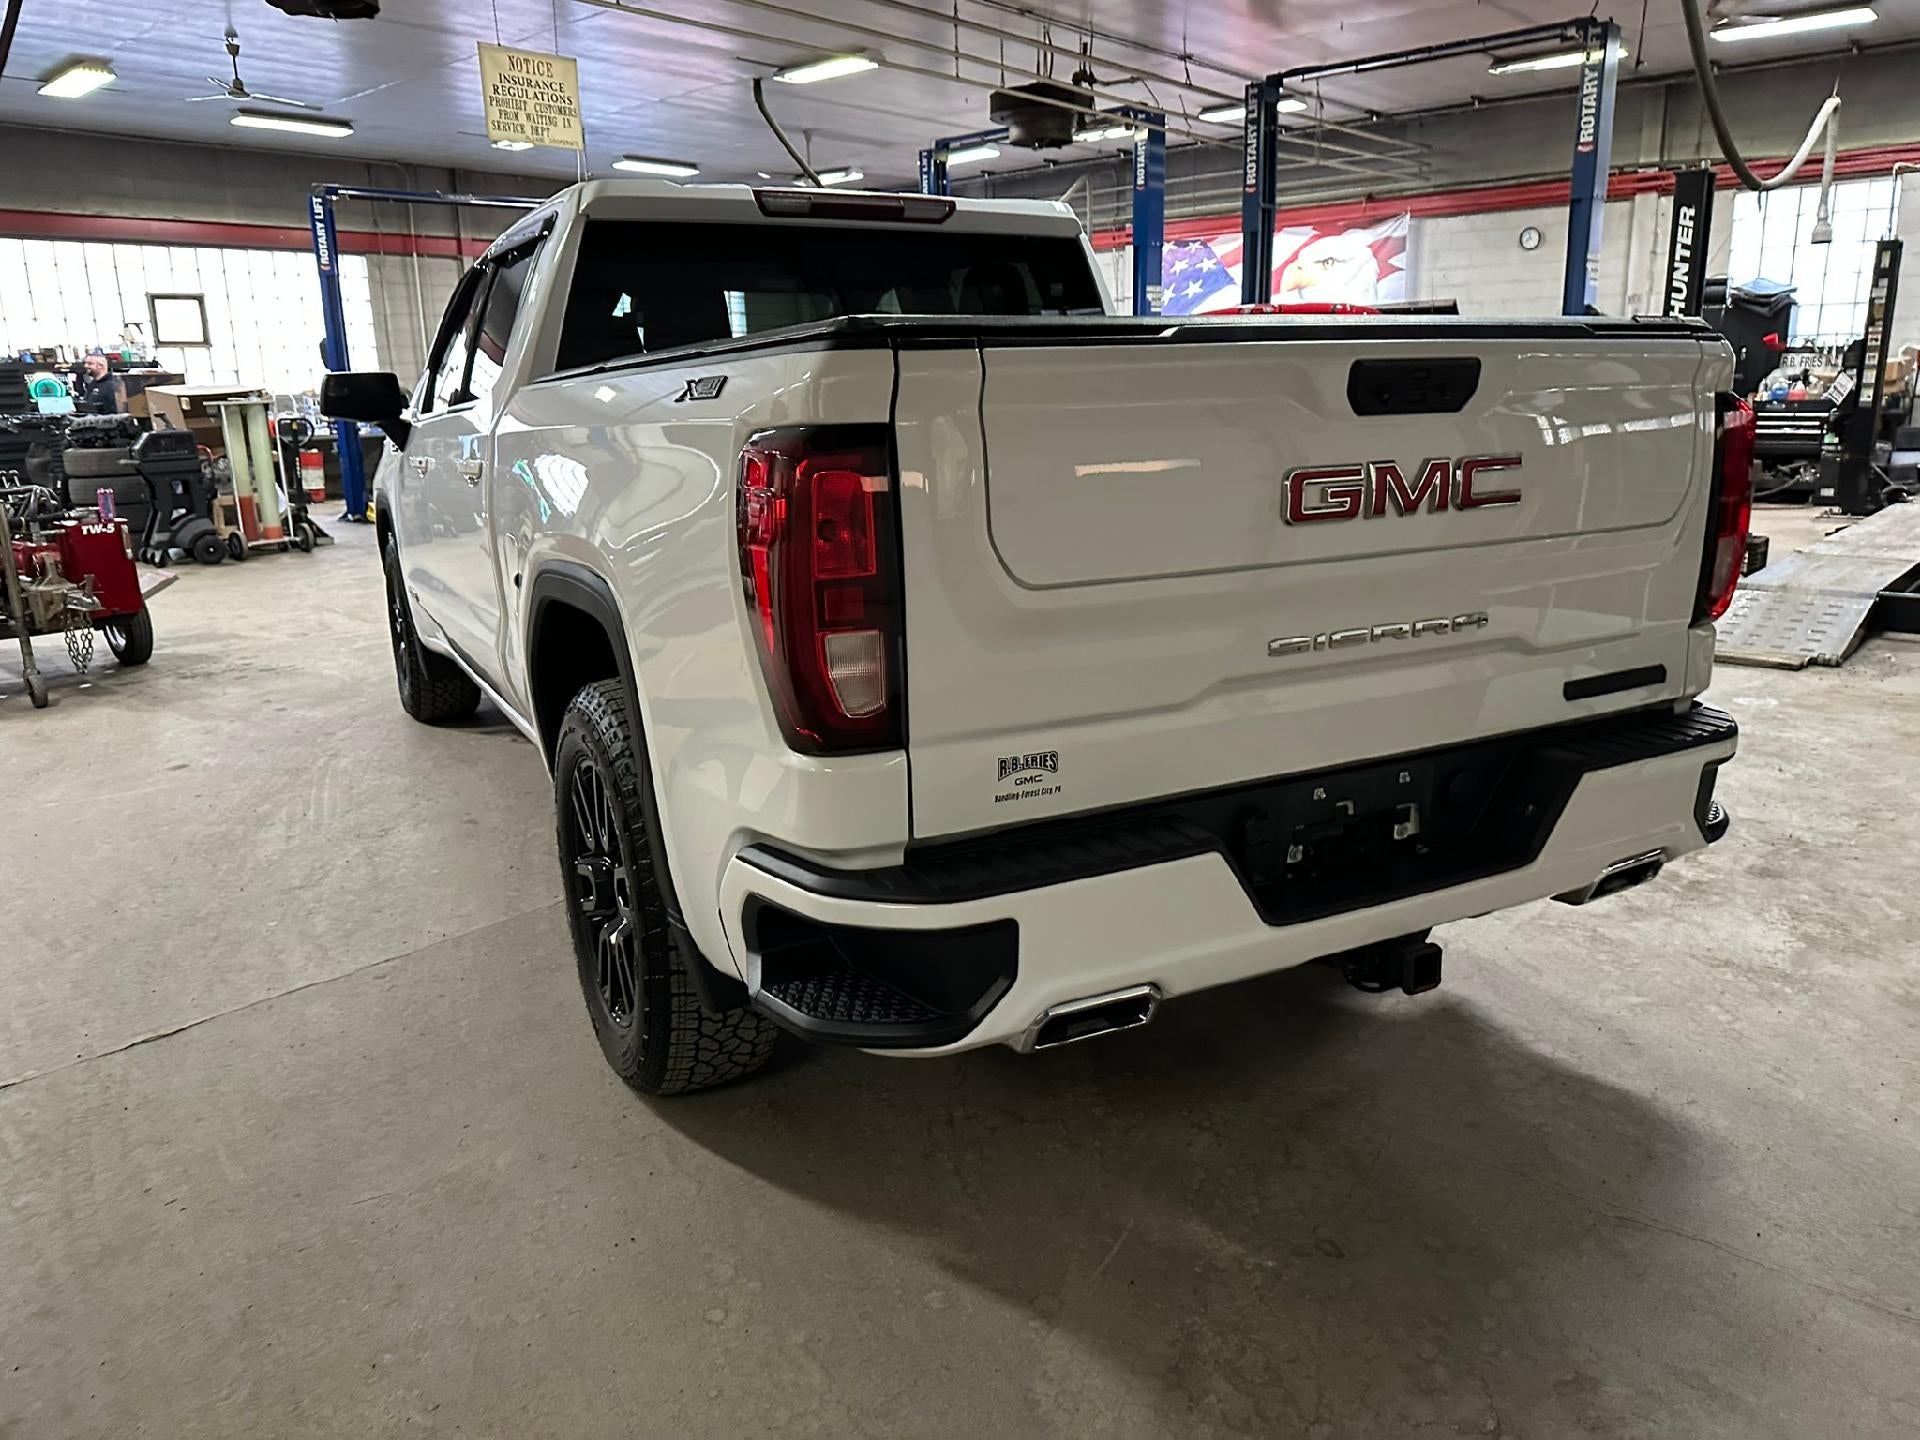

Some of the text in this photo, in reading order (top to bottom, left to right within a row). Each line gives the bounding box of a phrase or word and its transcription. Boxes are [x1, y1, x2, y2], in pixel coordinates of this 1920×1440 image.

[507, 55, 553, 78] NOTICE
[498, 73, 565, 93] INSURANCE
[492, 84, 573, 105] REGULATIONS
[1580, 67, 1599, 143] ROTARY
[489, 96, 578, 118] PROHIBIT CUSTOMERS
[491, 120, 526, 135] SERVICE
[499, 109, 572, 128] FROM WAITING IN
[1246, 86, 1259, 185] ROTARY LIFT
[312, 196, 330, 264] ROTARY LIFT
[1669, 205, 1696, 318] HUNTER
[1800, 355, 1823, 368] FRIES
[1280, 453, 1523, 527] GMC
[81, 523, 115, 536] TW-5
[1267, 611, 1489, 658] SIERRA
[1025, 752, 1058, 772] FRIES
[1014, 774, 1043, 786] GMC
